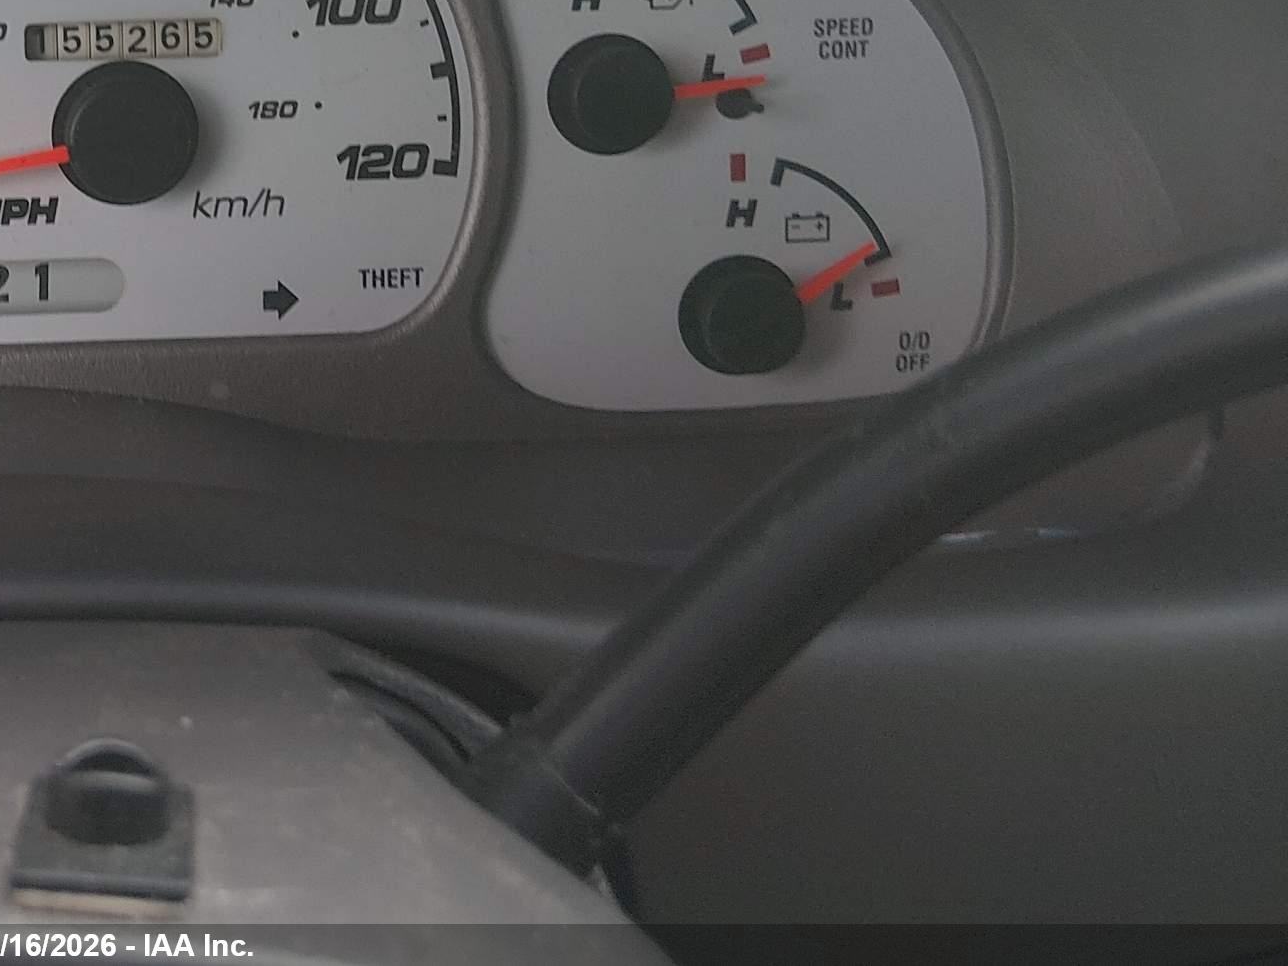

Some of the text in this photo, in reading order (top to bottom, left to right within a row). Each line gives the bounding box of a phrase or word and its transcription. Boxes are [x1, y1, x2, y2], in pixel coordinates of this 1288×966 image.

[37, 20, 214, 55] 155265
[813, 17, 874, 38] SPEED
[818, 40, 869, 60] CONT
[701, 54, 725, 82] L
[248, 99, 298, 119] 180
[336, 143, 430, 179] 120
[192, 188, 286, 219] km/h
[725, 198, 758, 228] H
[34, 262, 50, 301] 1
[359, 268, 423, 289] THEFT
[831, 283, 852, 310] L
[899, 331, 930, 351] O/D
[895, 353, 930, 372] OFF
